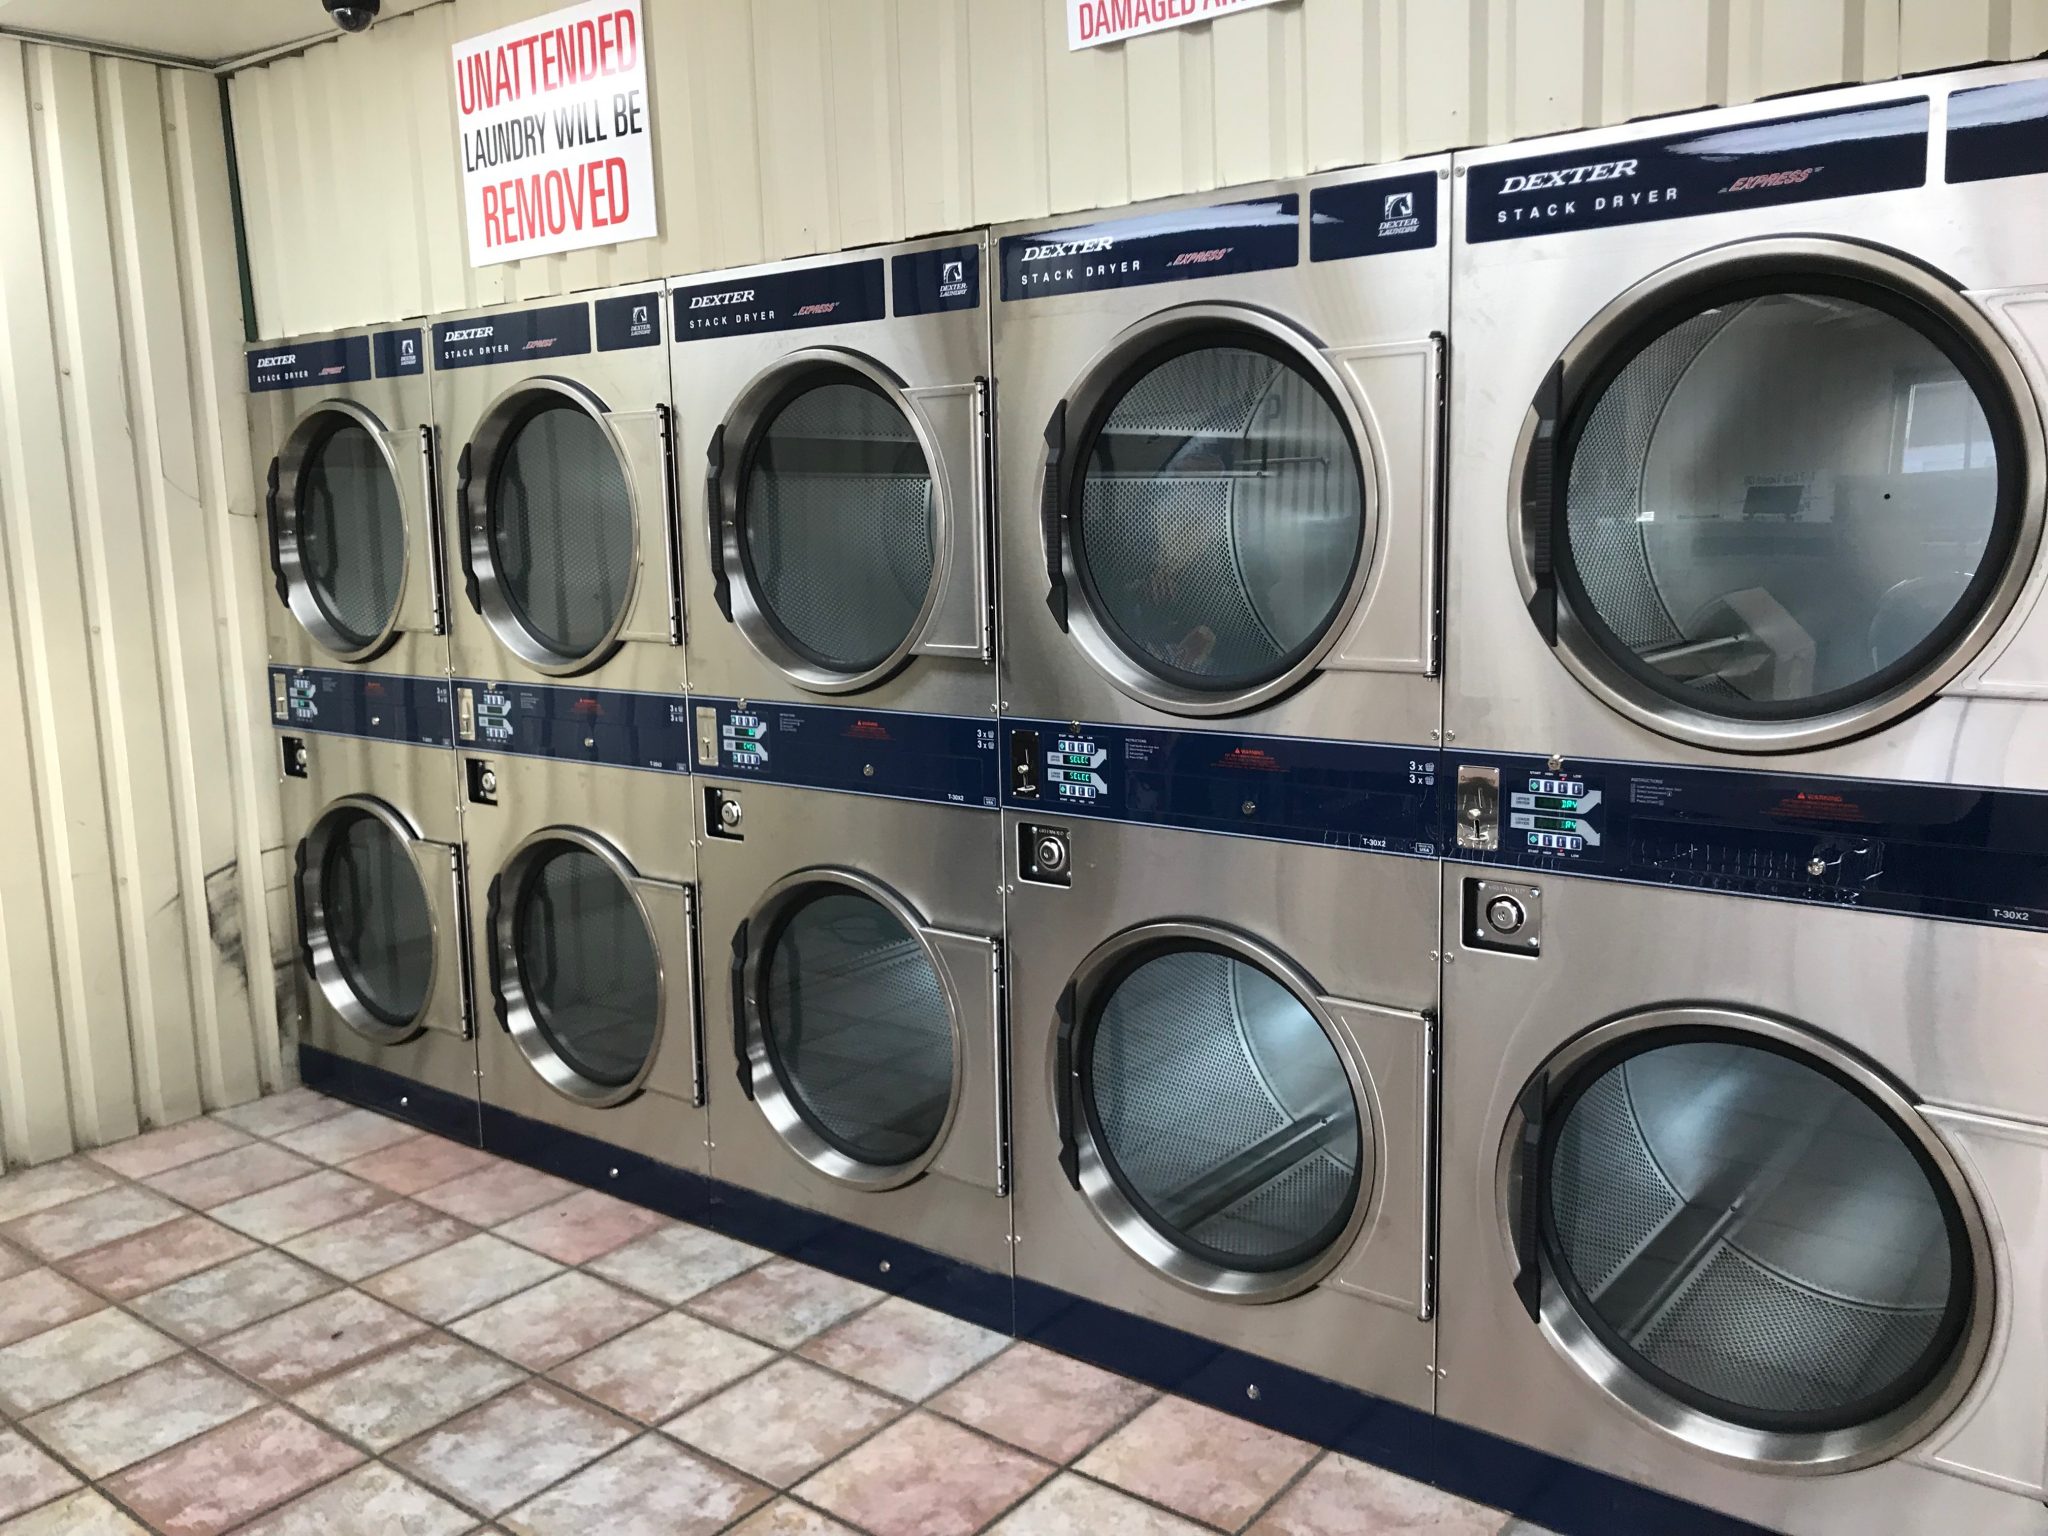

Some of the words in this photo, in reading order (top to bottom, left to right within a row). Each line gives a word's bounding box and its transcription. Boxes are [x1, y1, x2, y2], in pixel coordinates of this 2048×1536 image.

[457, 8, 637, 115] UNATTENDED
[464, 111, 546, 173] LAUNDRY
[553, 99, 608, 151] WILL
[613, 89, 643, 138] BE
[1498, 159, 1638, 195] DEXTER
[1728, 167, 1814, 192] EXPRESS
[482, 156, 630, 248] REMOVED
[1497, 201, 1576, 223] STACK
[1594, 188, 1677, 211] DRYER
[1379, 217, 1419, 231] DEXTER
[1021, 236, 1114, 262] DEXTER
[1172, 247, 1227, 266] EXPRESS
[1021, 269, 1074, 285] STACK
[1086, 260, 1140, 277] DRYER
[688, 289, 755, 310] DEXTER
[689, 316, 728, 329] STACK
[735, 310, 775, 323] DRYER
[444, 326, 494, 342] DEXTER
[257, 354, 296, 368] DEXTER
[444, 349, 474, 360] STACK
[479, 344, 509, 355] DRYER
[976, 729, 982, 737] 3
[977, 740, 982, 749] 3
[1409, 760, 1416, 770] 3
[1409, 774, 1416, 784] 3
[1418, 777, 1423, 785] x
[1362, 838, 1386, 847] T-30X2
[1992, 908, 2029, 921] T-30X2
